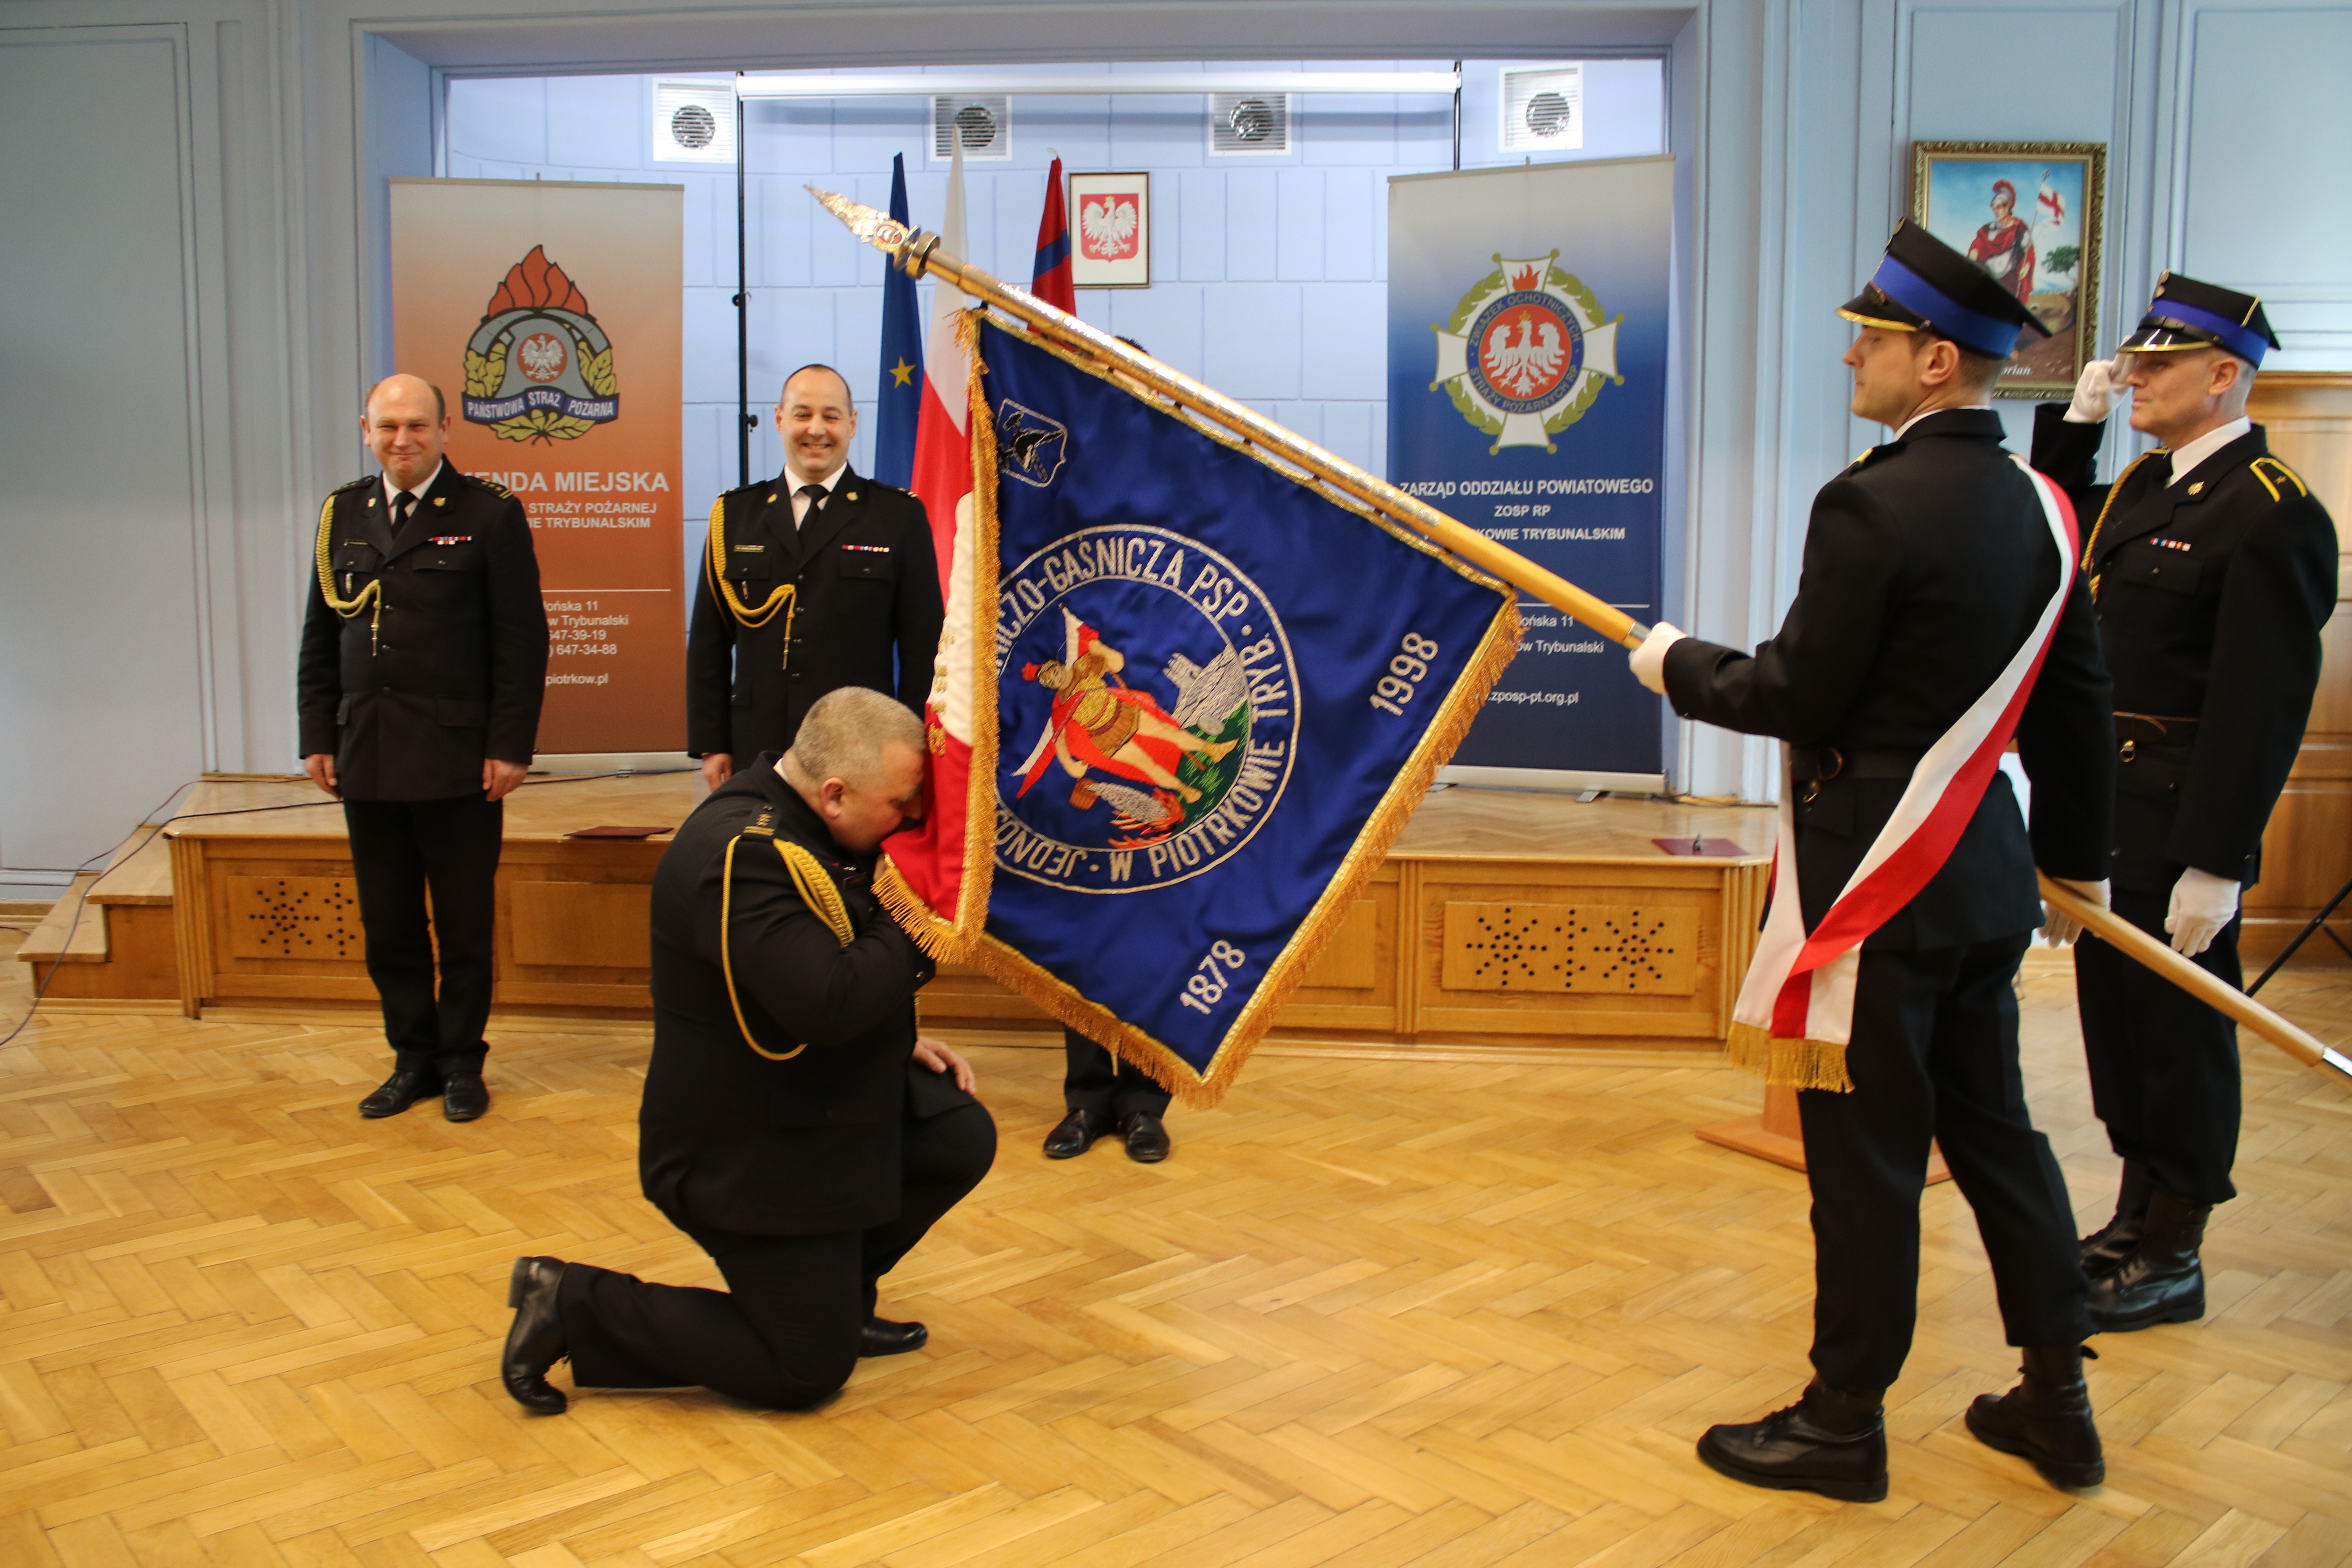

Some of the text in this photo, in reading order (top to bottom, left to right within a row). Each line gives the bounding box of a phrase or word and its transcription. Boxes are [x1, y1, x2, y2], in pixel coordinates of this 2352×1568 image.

[1507, 292, 1581, 343] OCHOTNICZYCH
[1501, 385, 1569, 413] POŻARNYCH
[1566, 365, 1579, 387] RP
[467, 392, 614, 419] PAŃSTWOWA STRAŻ POŻARNA
[555, 472, 670, 492] MIEJSKA
[1400, 478, 1653, 499] ZARZĄD ODDZIAŁU POWIATOWEGO
[528, 501, 581, 514] STRAŻY
[585, 501, 657, 514] POŻARNEJ
[1494, 505, 1551, 517] ZOSP RP
[546, 517, 650, 528] TRYBUNALSKIM
[1522, 528, 1625, 539] TRYBUNALSKIM
[1188, 563, 1249, 622] PSP
[586, 601, 599, 611] 11
[561, 614, 629, 628] Trybunalski
[1561, 615, 1573, 628] 11
[556, 643, 617, 655] 647-34-88
[1535, 639, 1604, 655] Trybunalski
[1369, 632, 1440, 716] 1998
[1109, 851, 1133, 882] W
[1149, 739, 1285, 878] PIOTRKOWIE
[1179, 938, 1247, 1015] 1878
